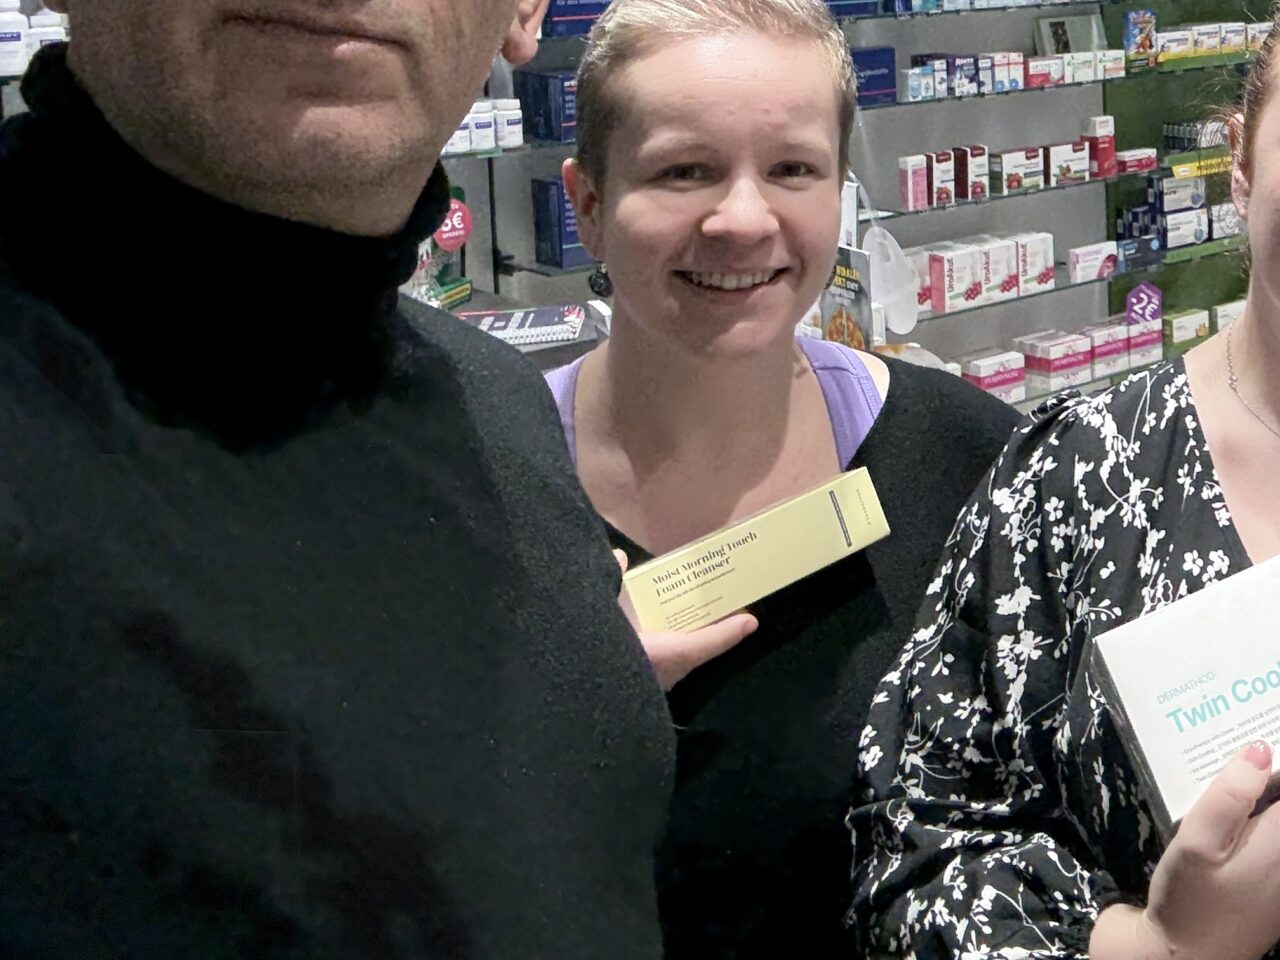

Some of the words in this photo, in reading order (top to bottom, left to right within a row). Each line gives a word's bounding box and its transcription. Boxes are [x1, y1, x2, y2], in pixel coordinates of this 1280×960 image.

[652, 567, 681, 585] Moist
[682, 546, 726, 572] Morning
[727, 531, 758, 552] Touch
[656, 577, 686, 597] Foam
[687, 556, 731, 582] Cleanser
[1156, 671, 1216, 704] DERMATHOD
[1166, 690, 1231, 733] Twin
